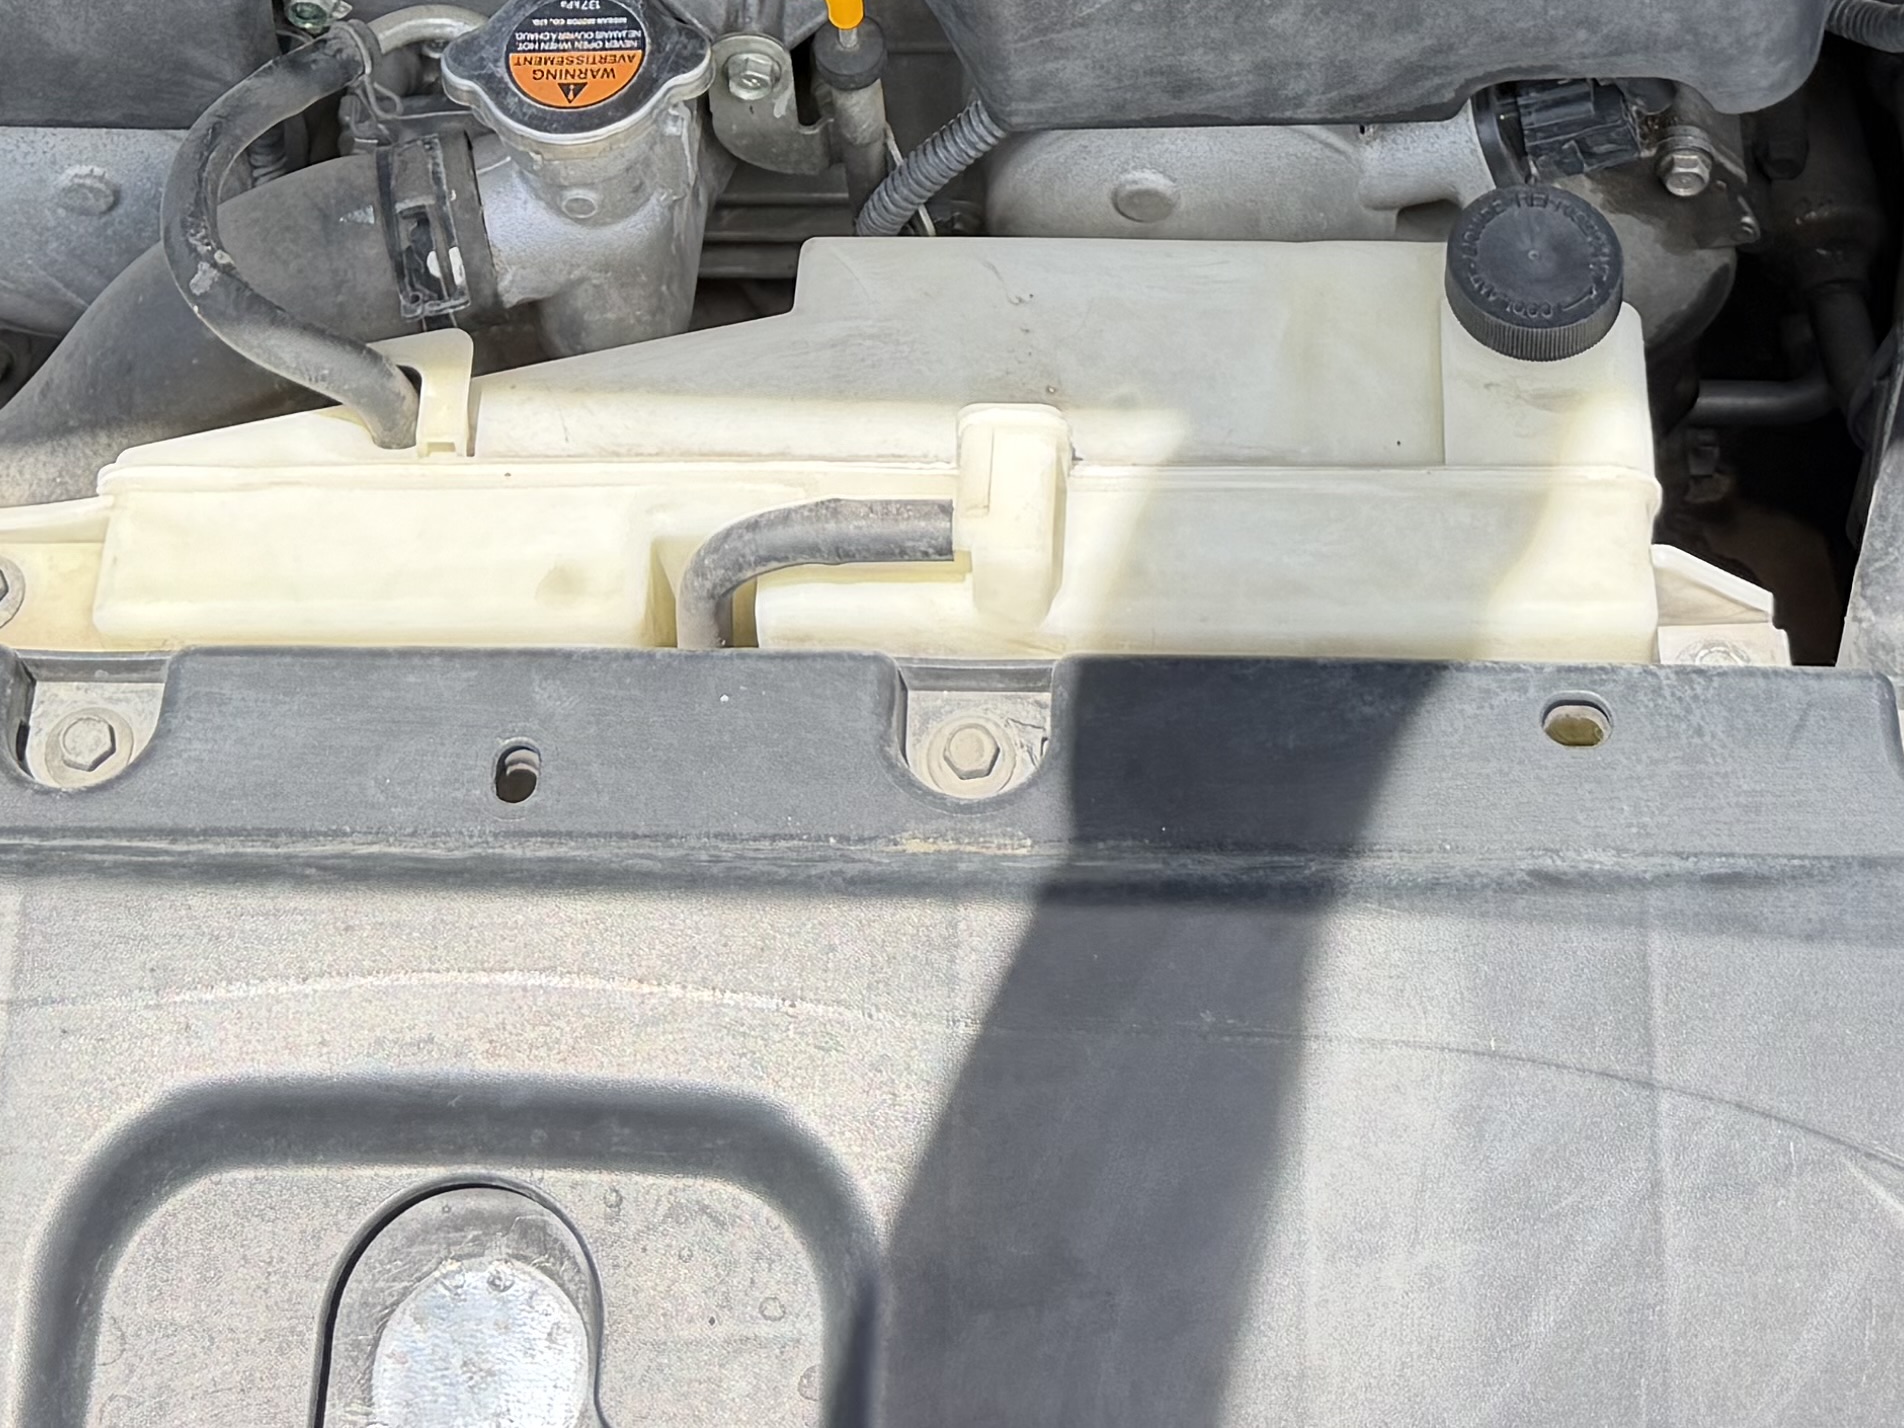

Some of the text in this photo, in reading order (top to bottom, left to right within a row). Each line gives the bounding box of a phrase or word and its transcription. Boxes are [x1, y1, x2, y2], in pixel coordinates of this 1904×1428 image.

[560, 0, 601, 9] 137 kPa
[541, 41, 572, 49] WHEN
[574, 40, 603, 48] OPEN
[605, 39, 638, 48] NEVER
[513, 54, 636, 66] AVERTISSEMENT
[532, 68, 615, 81] WARNING
